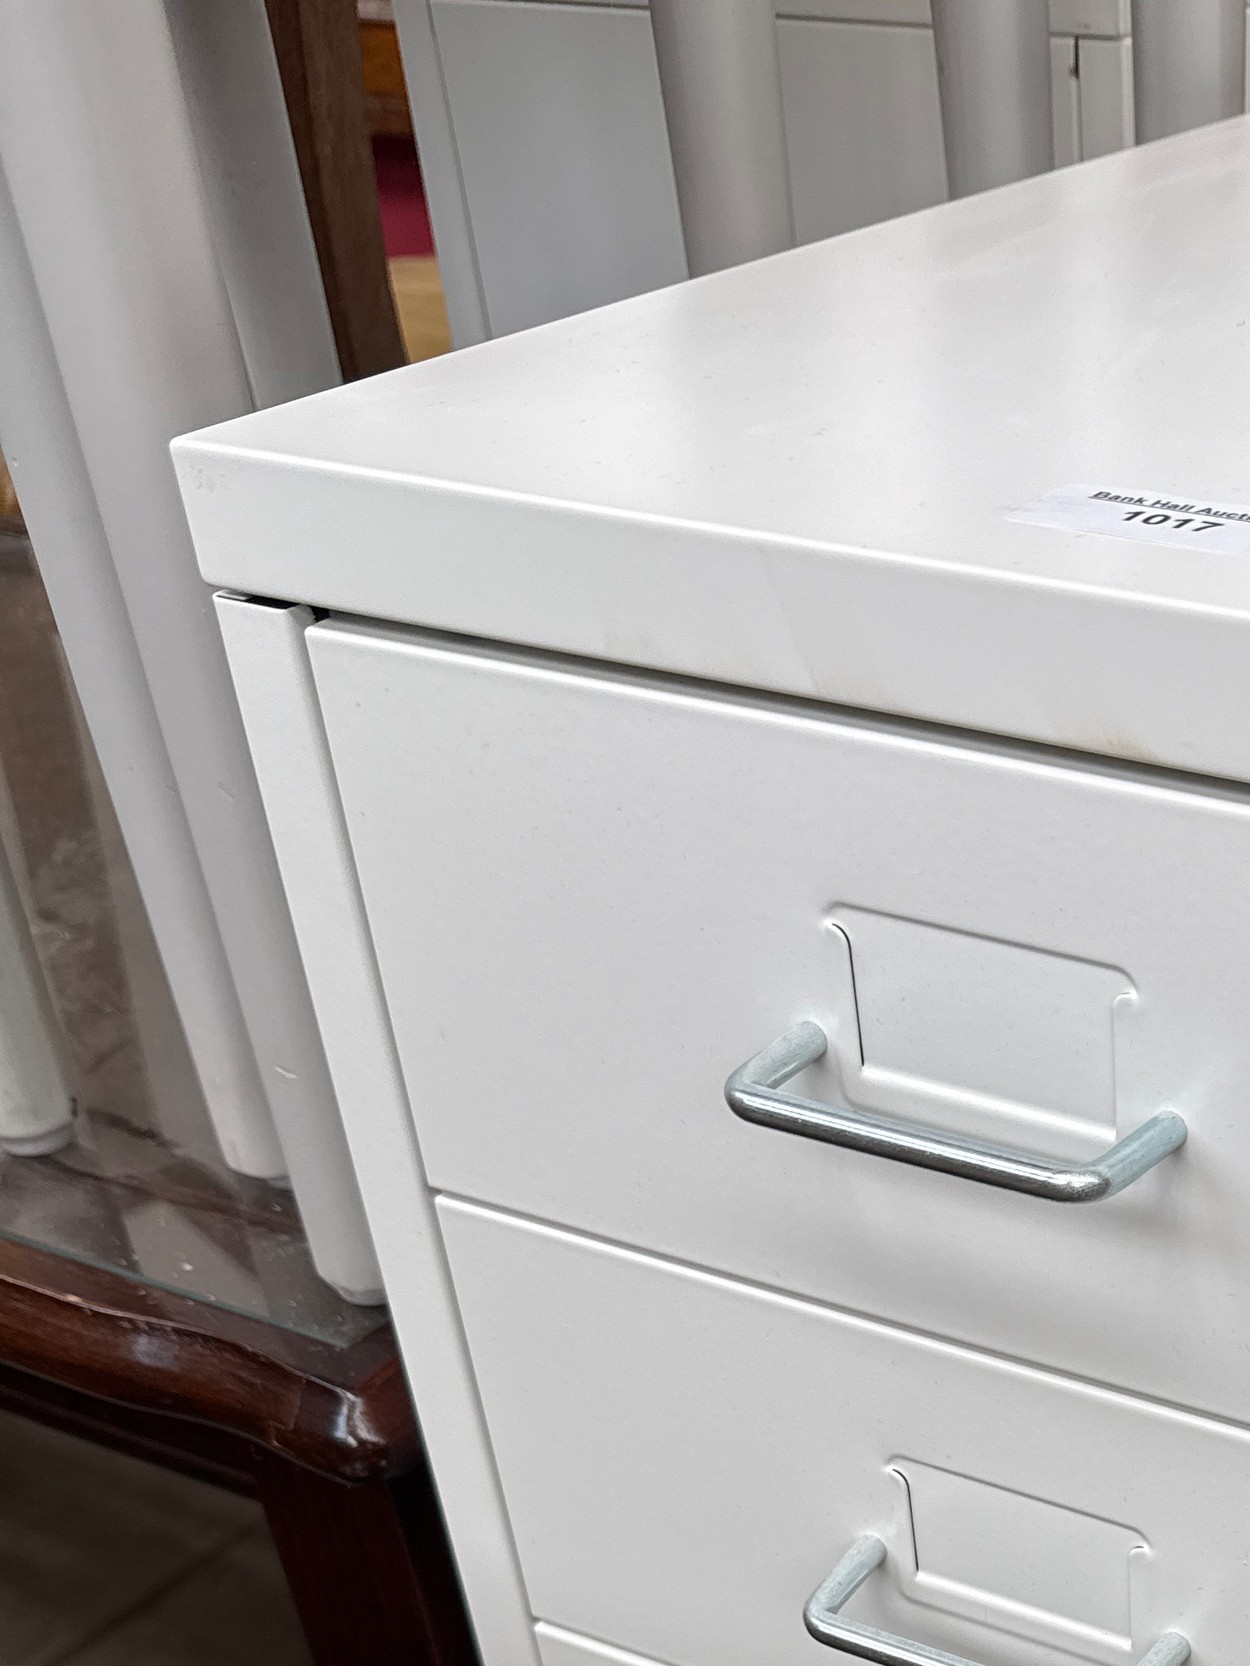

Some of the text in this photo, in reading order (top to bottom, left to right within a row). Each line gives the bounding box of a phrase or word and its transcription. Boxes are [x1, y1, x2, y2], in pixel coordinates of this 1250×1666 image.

[1092, 491, 1148, 506] Bank
[1151, 499, 1196, 513] Hall
[1122, 511, 1225, 533] 1017
